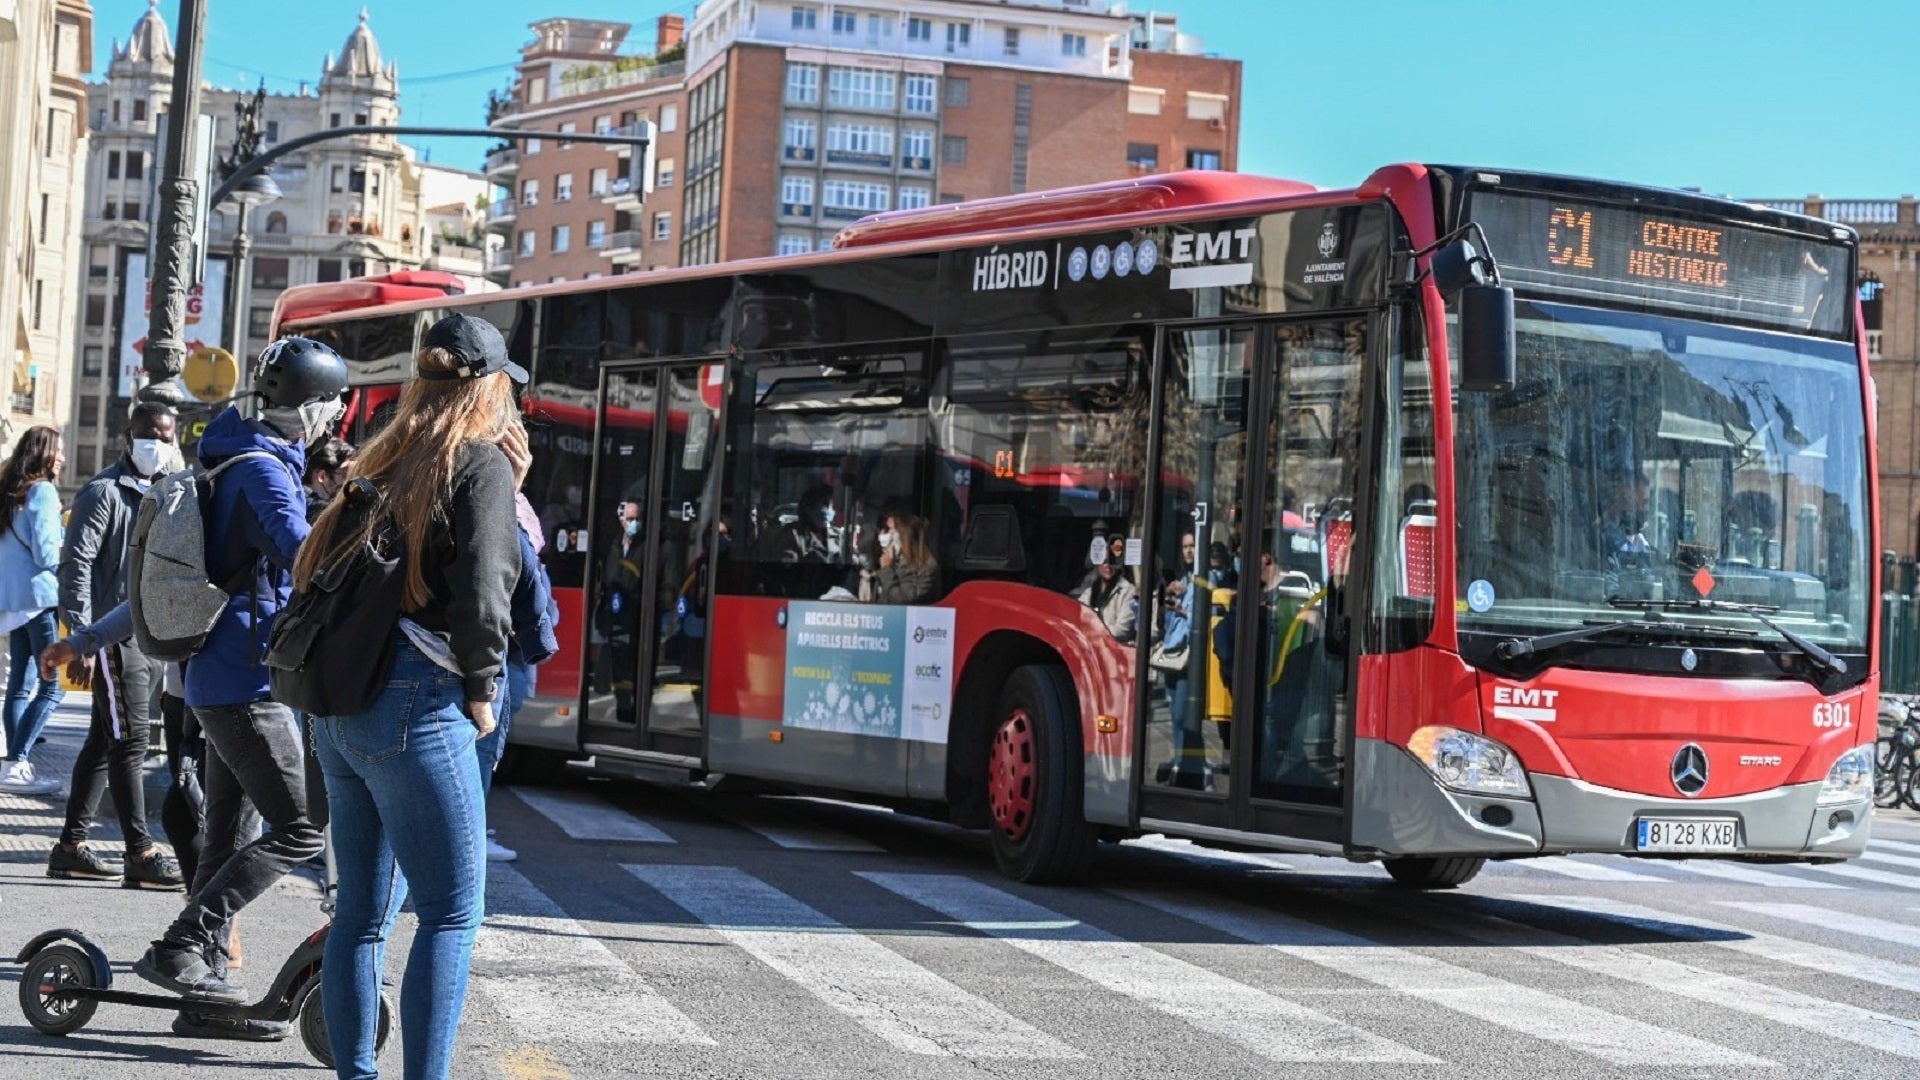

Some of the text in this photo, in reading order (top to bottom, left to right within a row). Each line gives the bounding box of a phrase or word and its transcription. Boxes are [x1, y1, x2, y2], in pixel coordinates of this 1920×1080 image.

[1171, 228, 1257, 264] EMT
[1548, 207, 1595, 269] C1
[1642, 220, 1723, 256] CENTRE
[973, 244, 1048, 292] HÍBRID
[1304, 275, 1313, 284] DE
[1305, 262, 1346, 273] AJUNTAMENT
[1628, 249, 1728, 287] HISTORIC
[995, 450, 1015, 478] C1
[804, 611, 884, 630] RECICLA ELS TEUS
[797, 631, 841, 649] APARELLS
[1493, 686, 1559, 708] EMT
[1812, 702, 1853, 728] 6301
[1650, 823, 1733, 845] 8128 KXB
